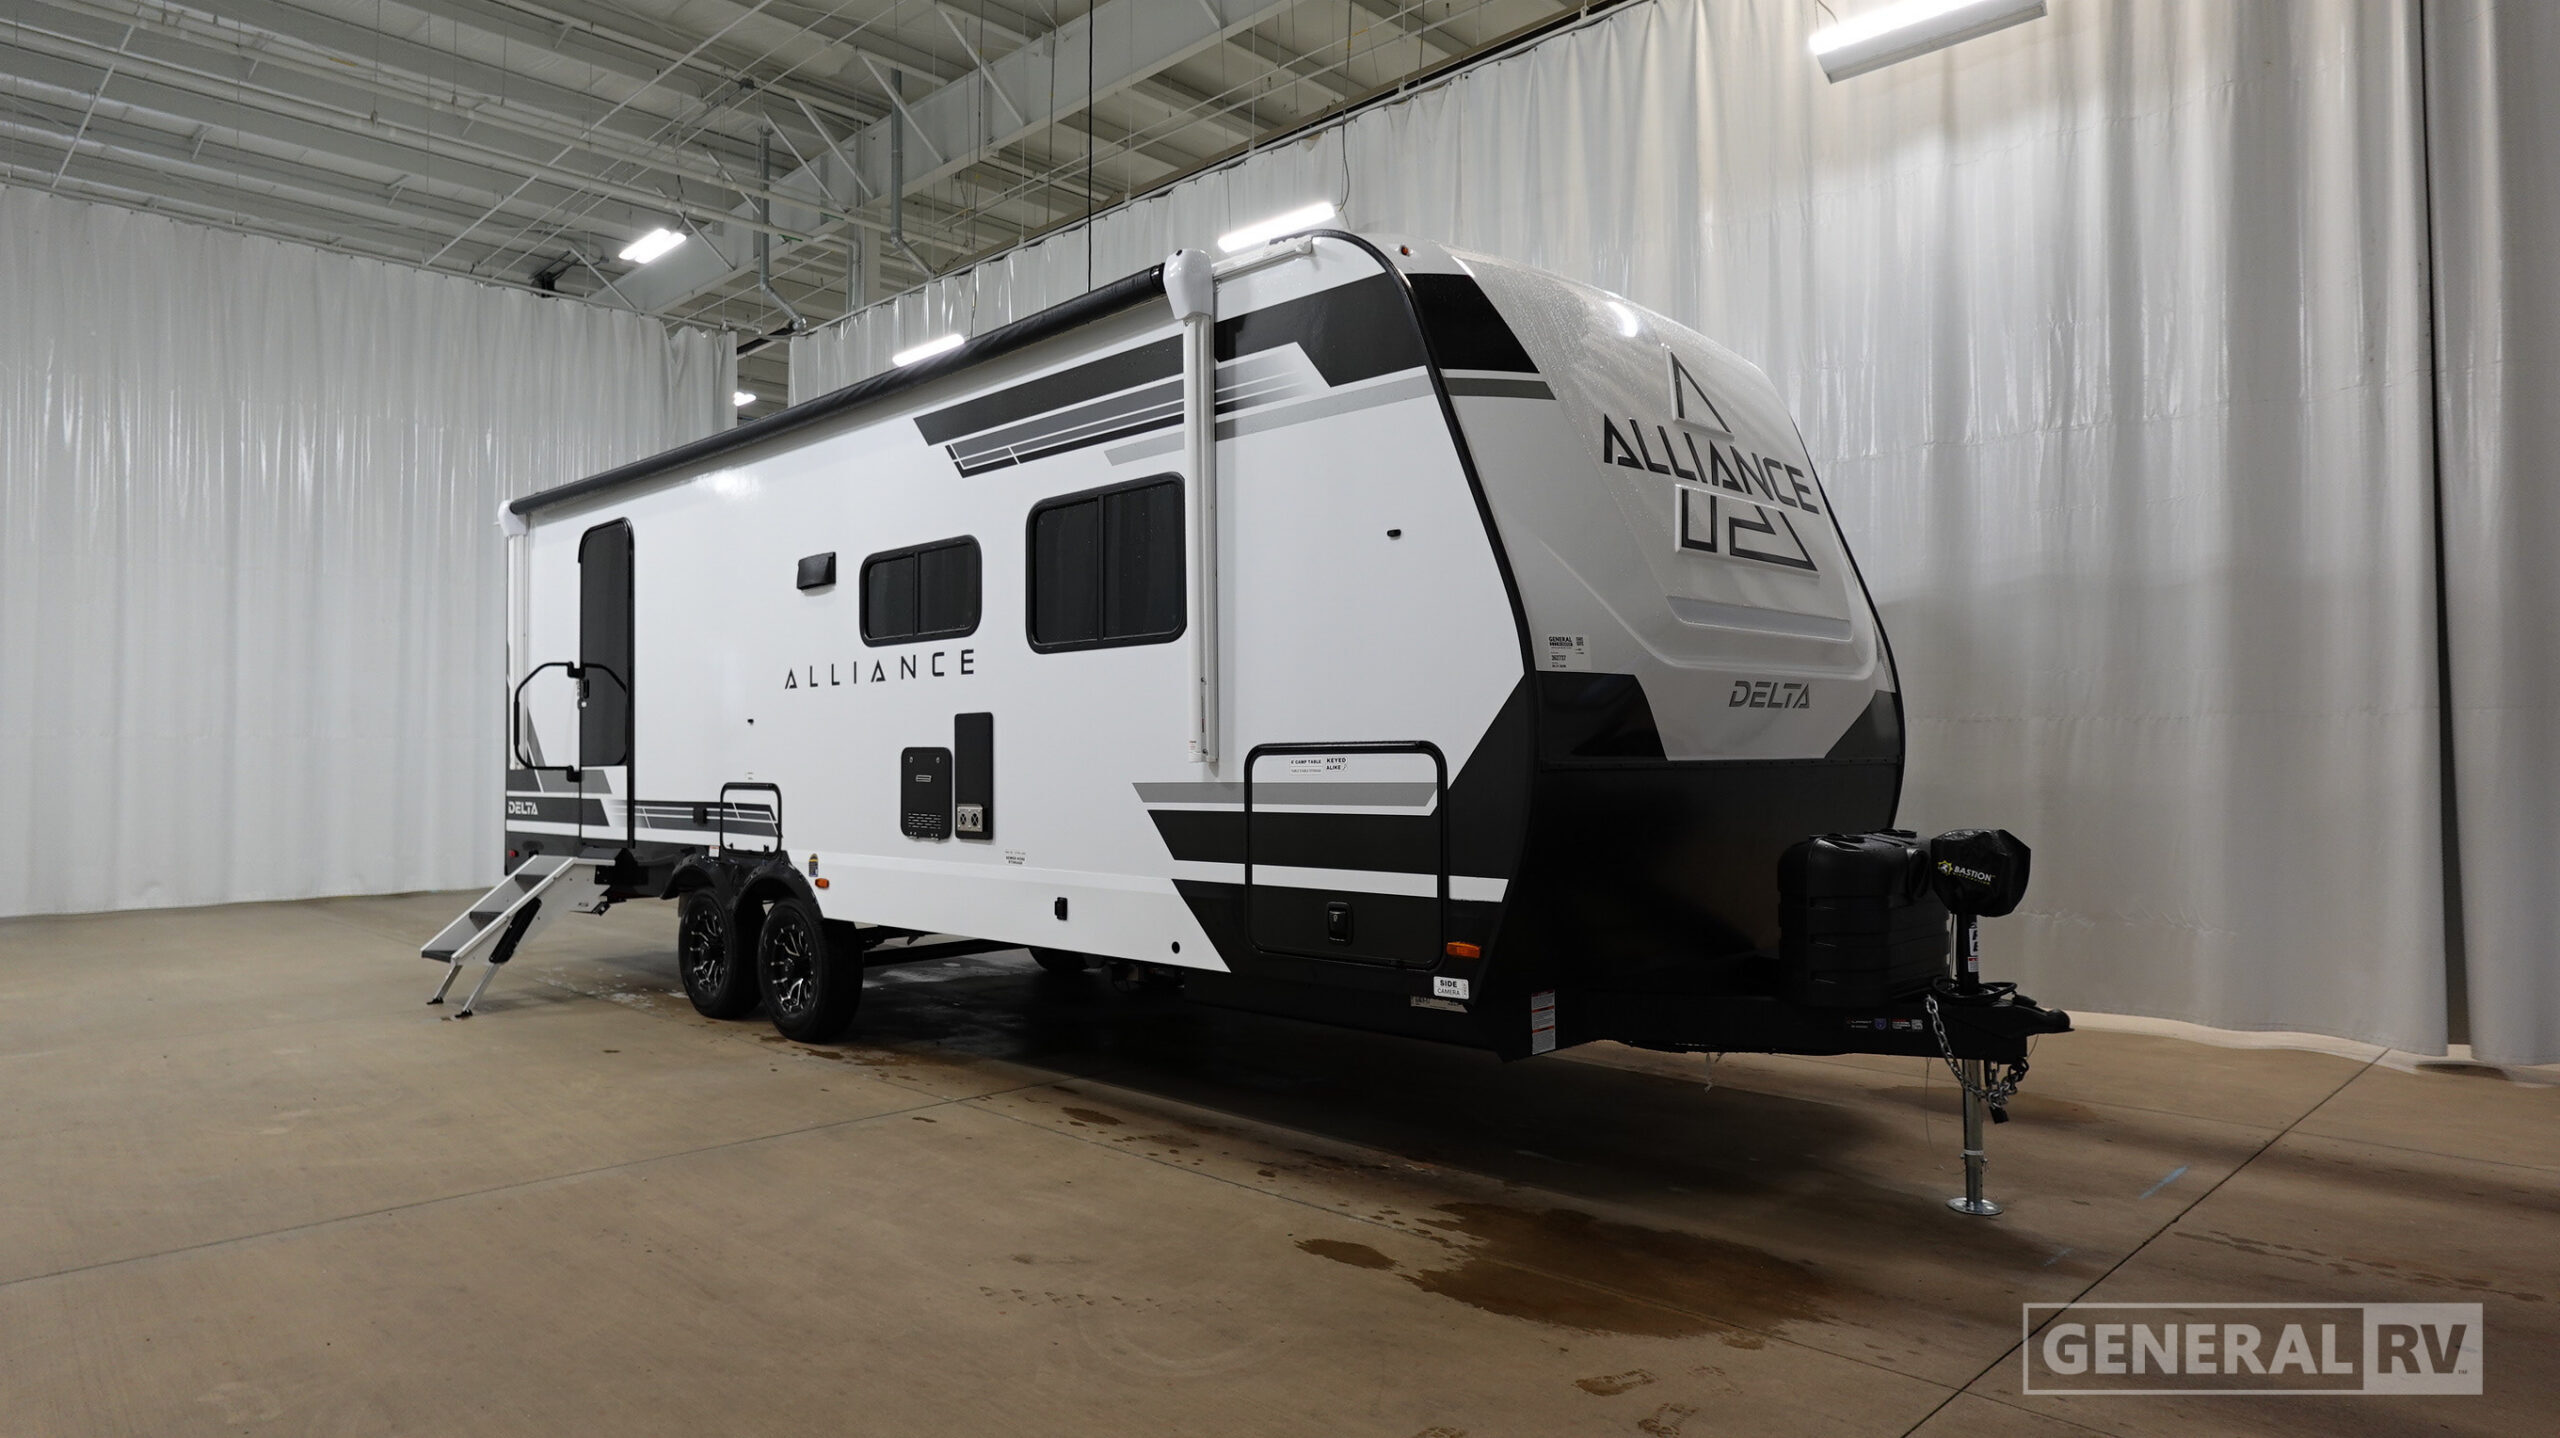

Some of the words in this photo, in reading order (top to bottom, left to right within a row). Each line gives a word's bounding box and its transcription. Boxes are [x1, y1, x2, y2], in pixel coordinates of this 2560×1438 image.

[1603, 413, 1820, 515] ALLIANCE
[784, 648, 974, 690] ALLIANCE
[1728, 680, 1810, 709] DELTA
[508, 801, 539, 815] DELTA
[1954, 865, 1992, 882] BASTION
[1437, 988, 1460, 996] CAMERA
[1440, 979, 1458, 988] SIDE
